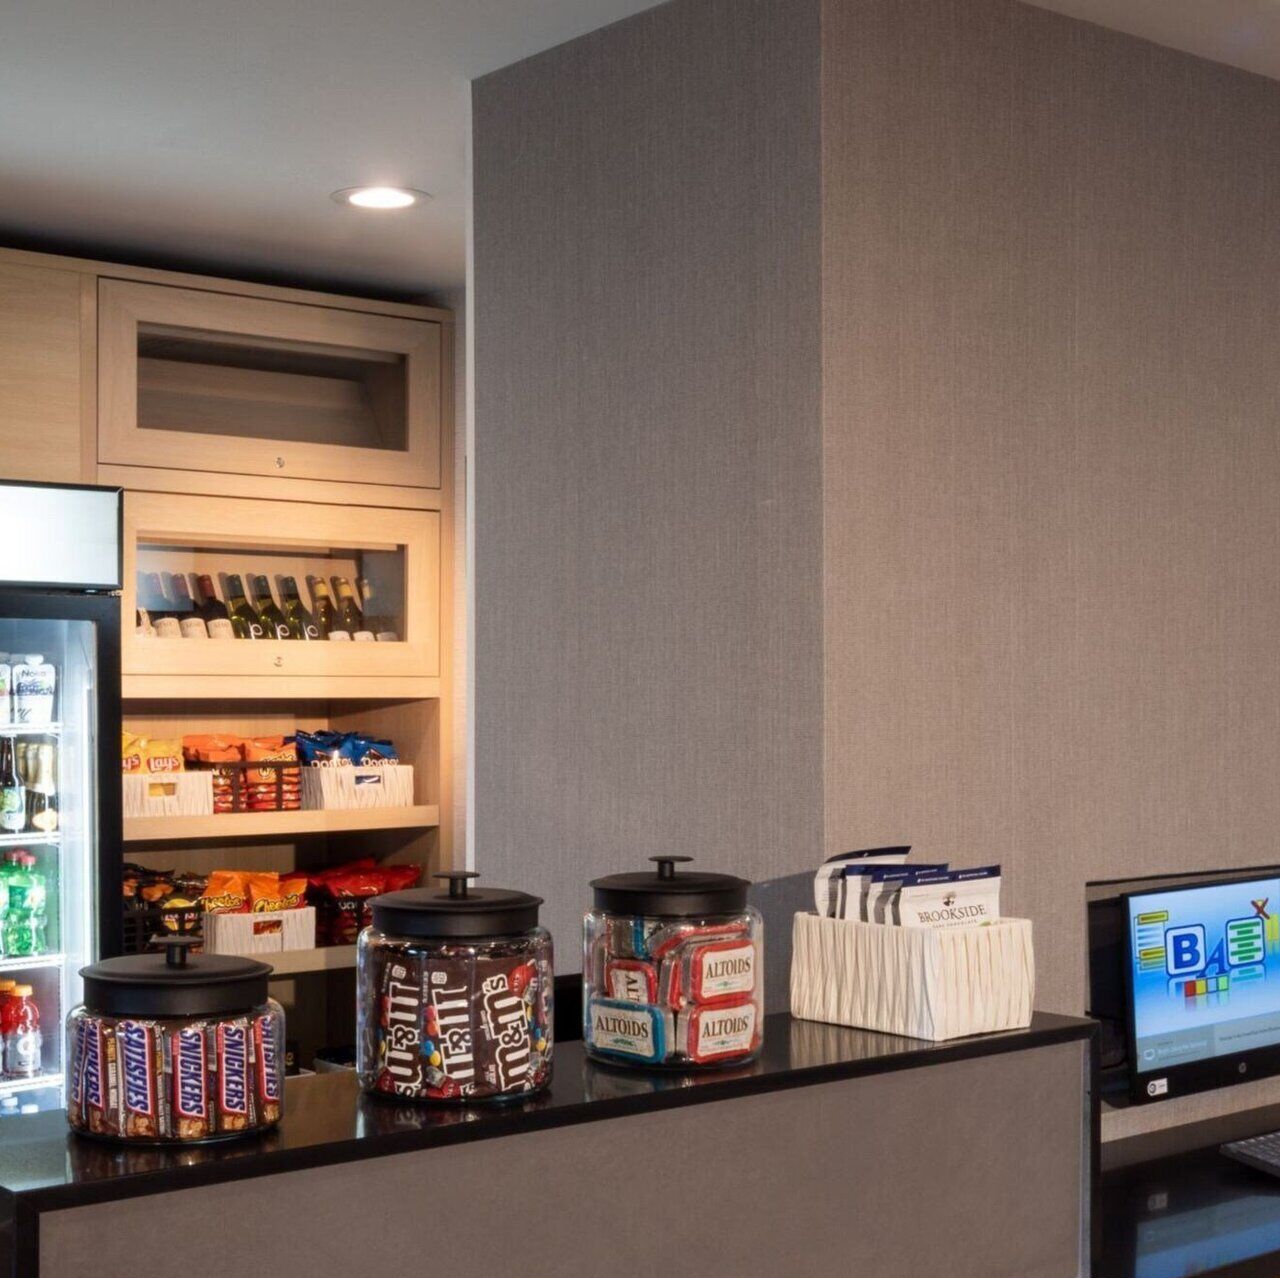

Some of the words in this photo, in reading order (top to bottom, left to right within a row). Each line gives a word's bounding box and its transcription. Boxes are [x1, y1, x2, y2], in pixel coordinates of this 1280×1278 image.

[917, 904, 987, 923] BROOKSIDE
[705, 957, 751, 979] ALTOIDS
[596, 1016, 649, 1038] ALTOIDS
[702, 1016, 748, 1038] ALTOIDS
[124, 1021, 150, 1112] SATISFIES
[179, 1030, 205, 1115] SNICKERS
[223, 1026, 246, 1111] SNICKERS
